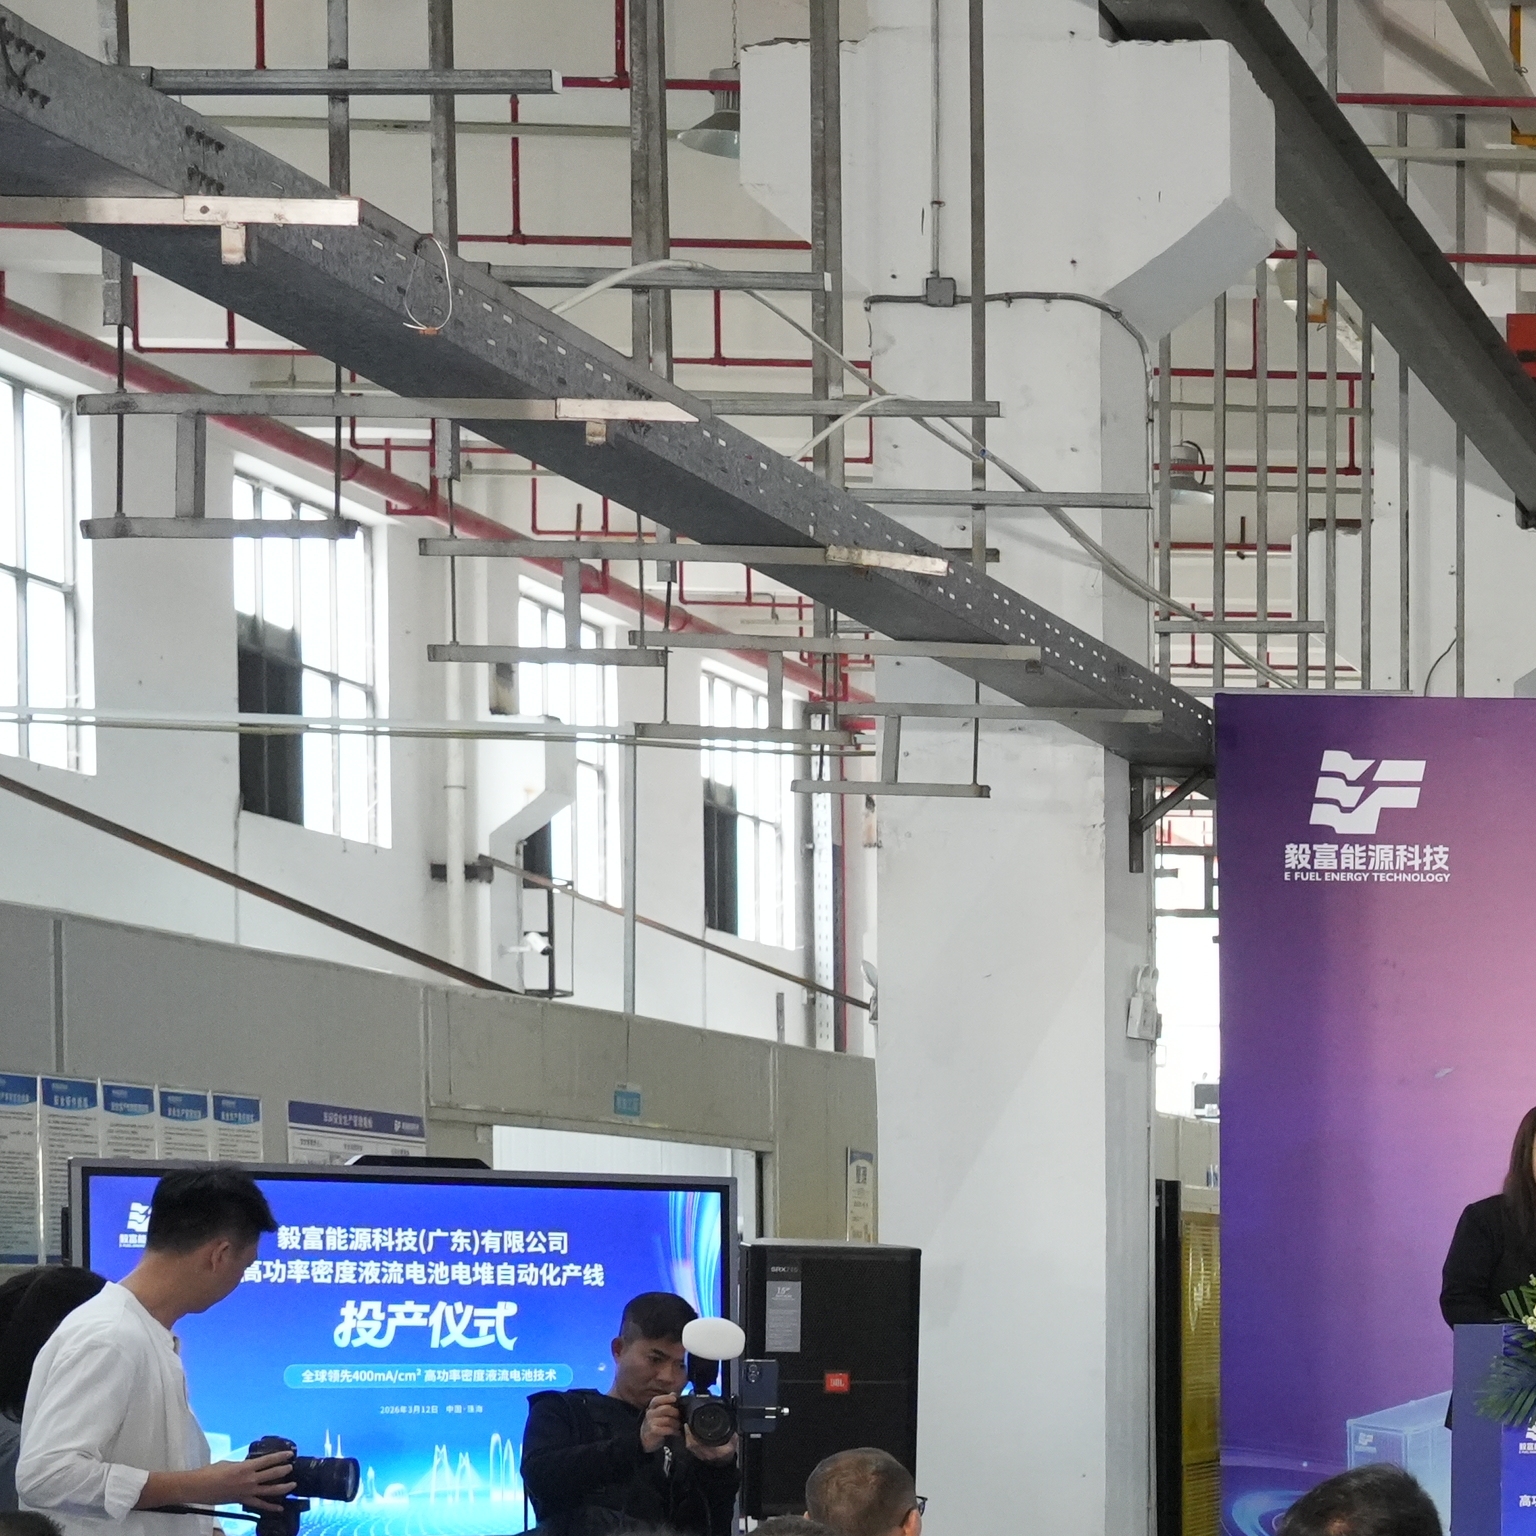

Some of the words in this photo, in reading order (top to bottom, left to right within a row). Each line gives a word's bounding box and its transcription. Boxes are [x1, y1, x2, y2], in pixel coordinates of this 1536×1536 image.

[1284, 843, 1450, 871] 毅富能源科技
[1284, 872, 1291, 881] E
[1294, 872, 1322, 881] FUEL
[1324, 872, 1370, 882] ENERGY
[1372, 873, 1451, 883] TECHNOLOGY
[277, 1225, 569, 1257] 毅富能源科技(广东)有限公司
[241, 1259, 606, 1288] 高功率密度液流电池电堆自动化产线
[333, 1299, 518, 1351] 投产仪式
[424, 1368, 558, 1383] 高功率密度液流电池技术
